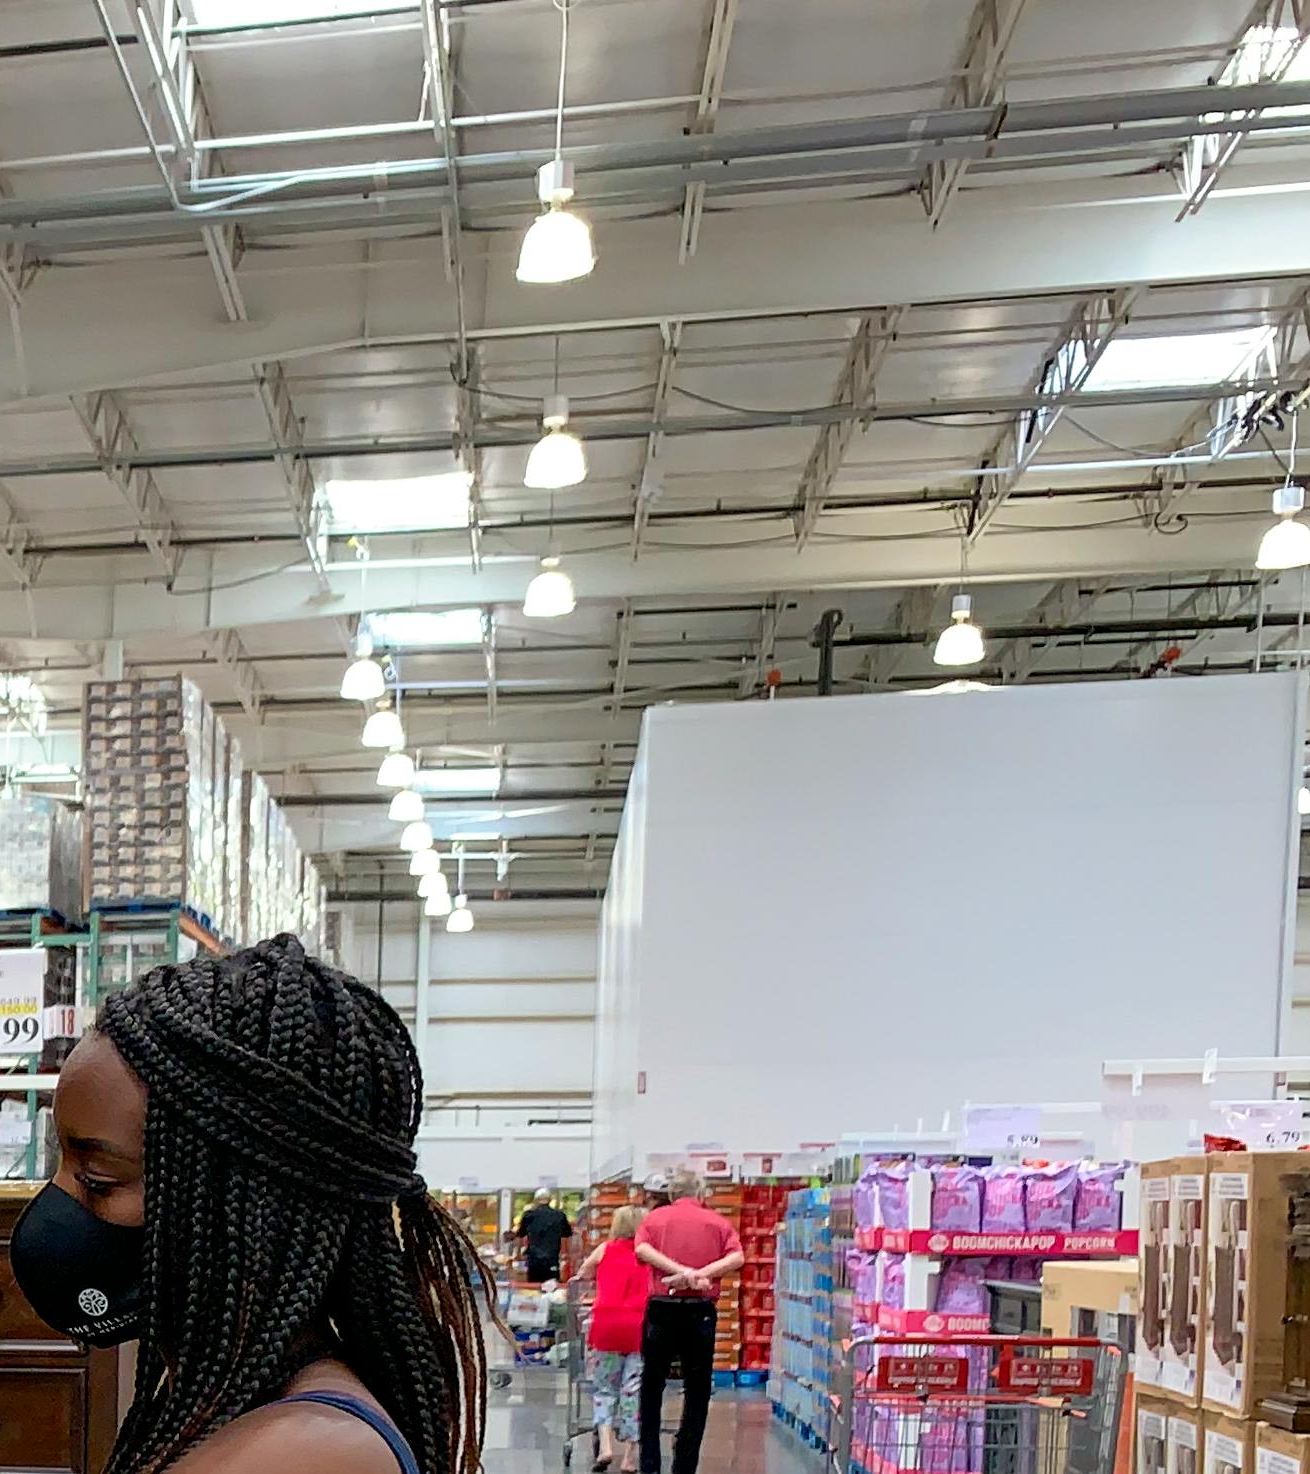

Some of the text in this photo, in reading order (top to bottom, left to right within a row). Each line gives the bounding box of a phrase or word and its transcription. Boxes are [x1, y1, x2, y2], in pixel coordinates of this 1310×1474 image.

[61, 1009, 75, 1035] 18
[952, 1235, 1116, 1250] BOOMCHICKAPOP POPCORN
